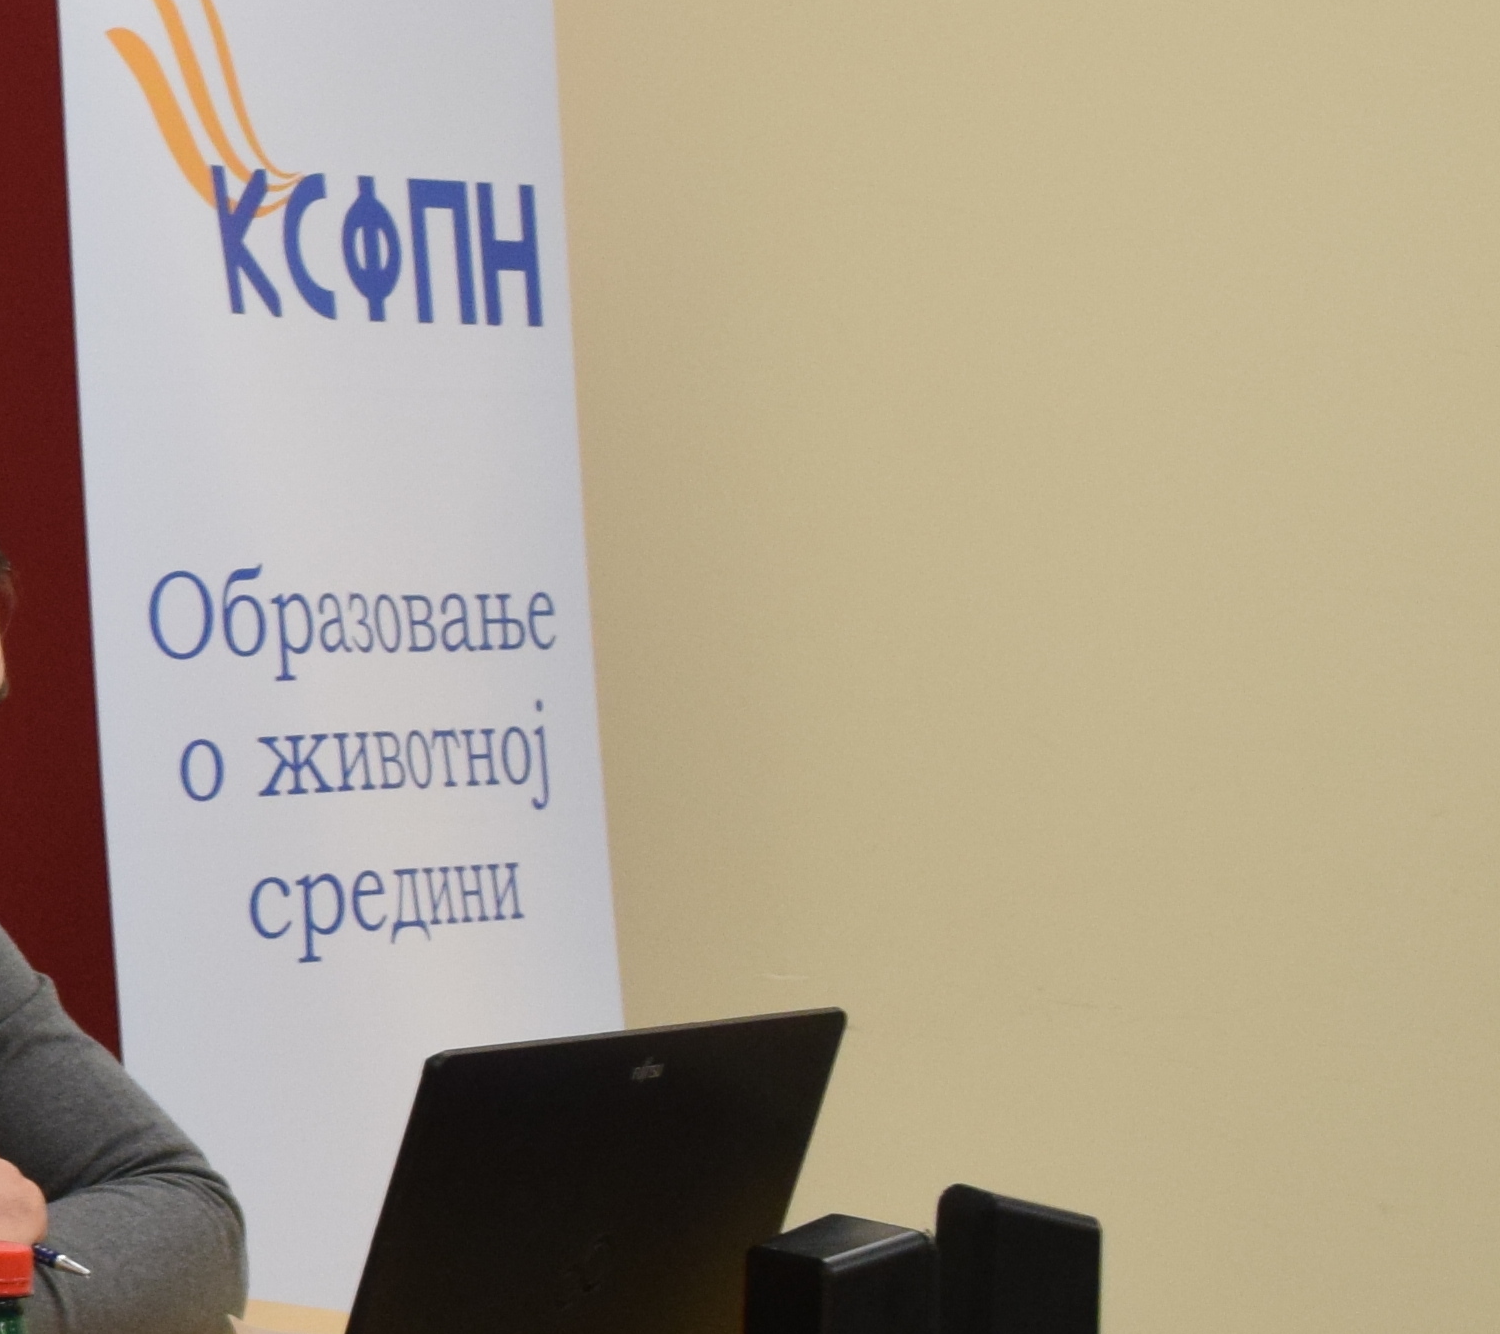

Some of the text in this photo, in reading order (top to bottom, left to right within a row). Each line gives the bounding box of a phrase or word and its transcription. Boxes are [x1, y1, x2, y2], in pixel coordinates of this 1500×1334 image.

[210, 164, 543, 327] КСФПН
[147, 565, 557, 681] Образовање
[180, 700, 552, 810] о животној
[248, 861, 525, 962] средини
